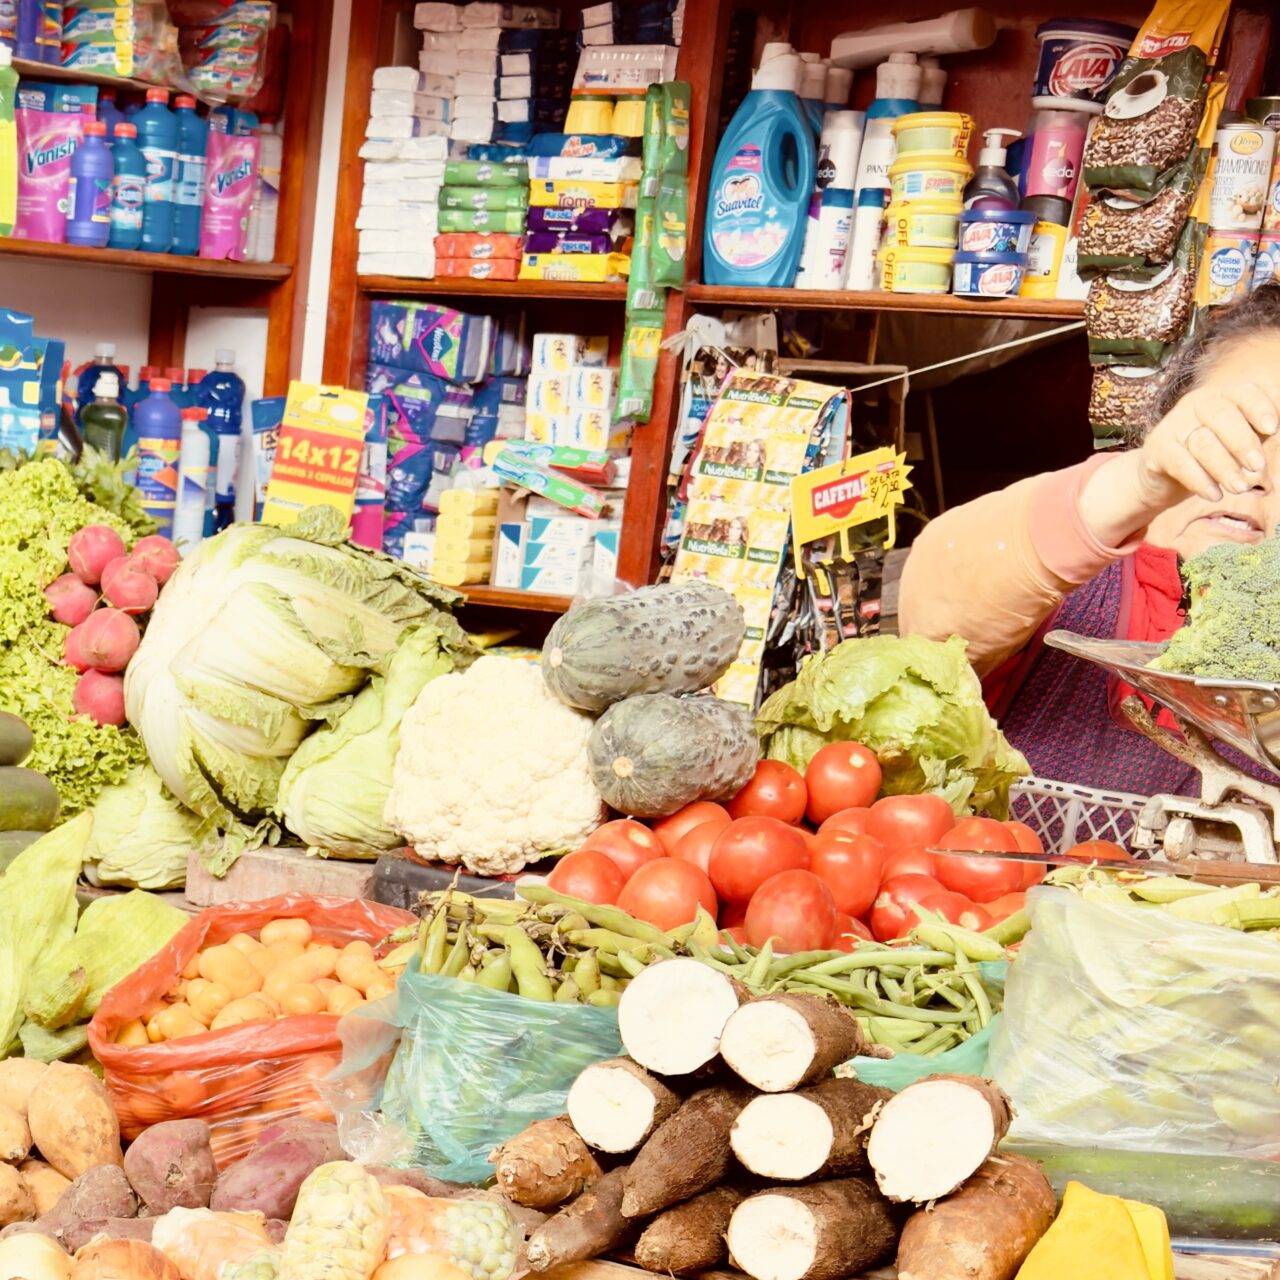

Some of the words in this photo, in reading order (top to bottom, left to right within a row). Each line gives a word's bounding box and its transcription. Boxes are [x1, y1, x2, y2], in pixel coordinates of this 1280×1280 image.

[26, 135, 77, 174] Vanish
[216, 158, 252, 195] Vanish
[558, 192, 596, 208] Trome
[717, 195, 763, 217] Suavitel
[280, 434, 361, 474] 14x12
